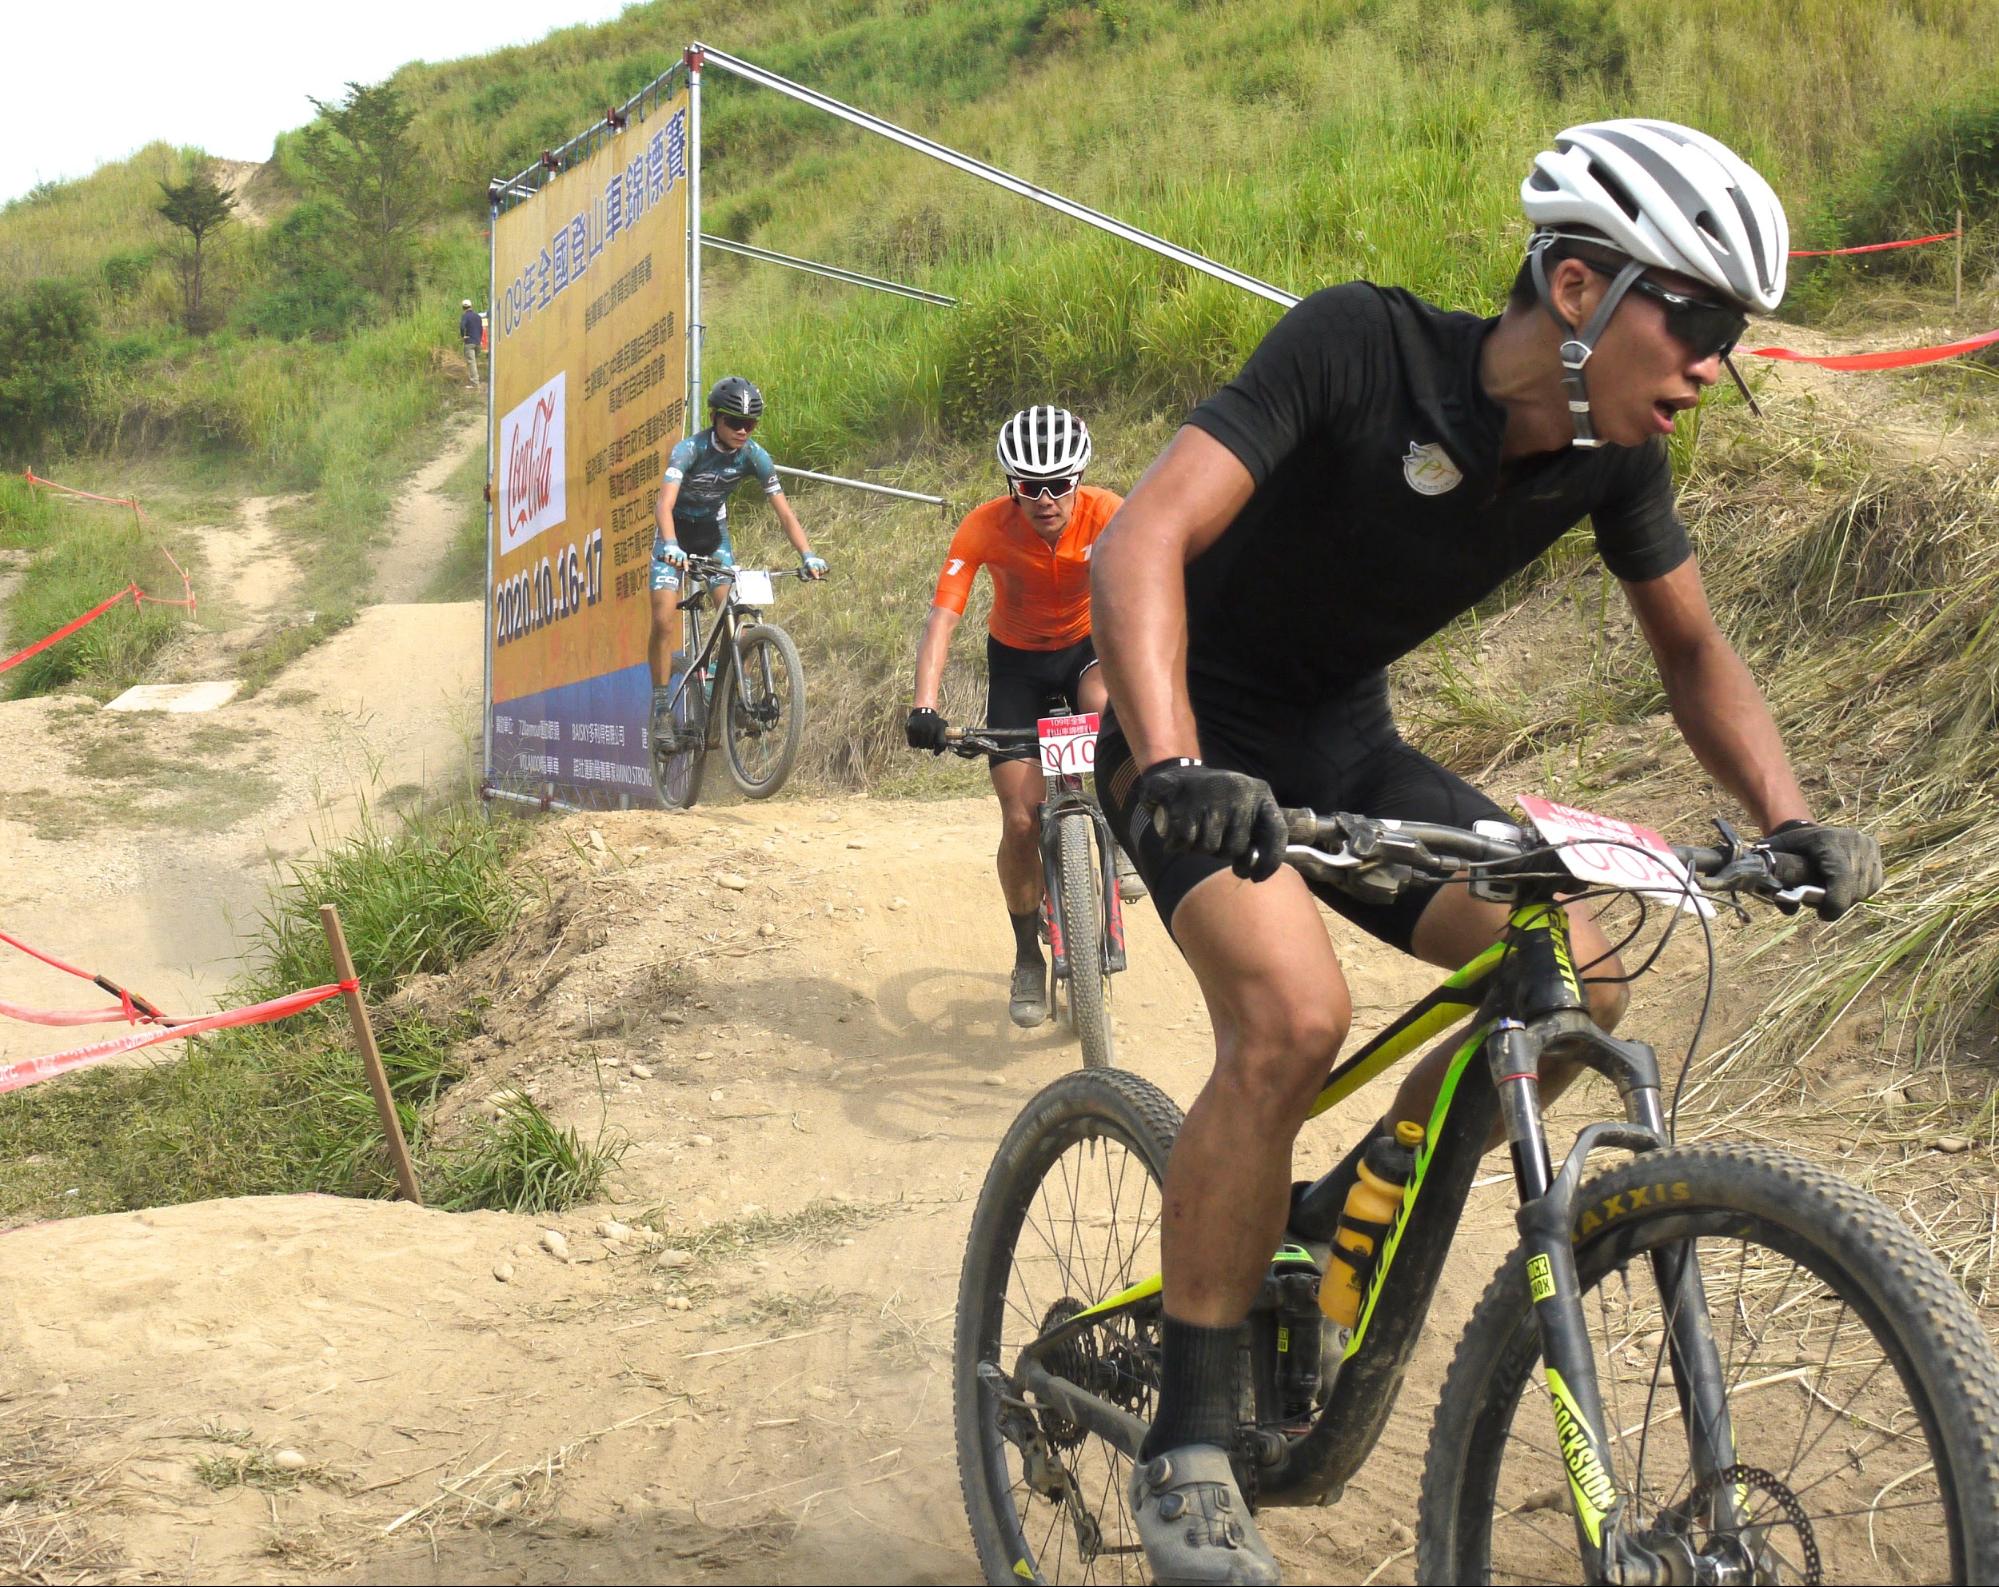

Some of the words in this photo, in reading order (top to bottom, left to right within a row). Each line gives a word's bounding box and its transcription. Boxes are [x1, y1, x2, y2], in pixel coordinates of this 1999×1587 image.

[494, 106, 687, 343] 109年全國登山車錦標賽
[495, 527, 604, 648] 2020.10.16-17
